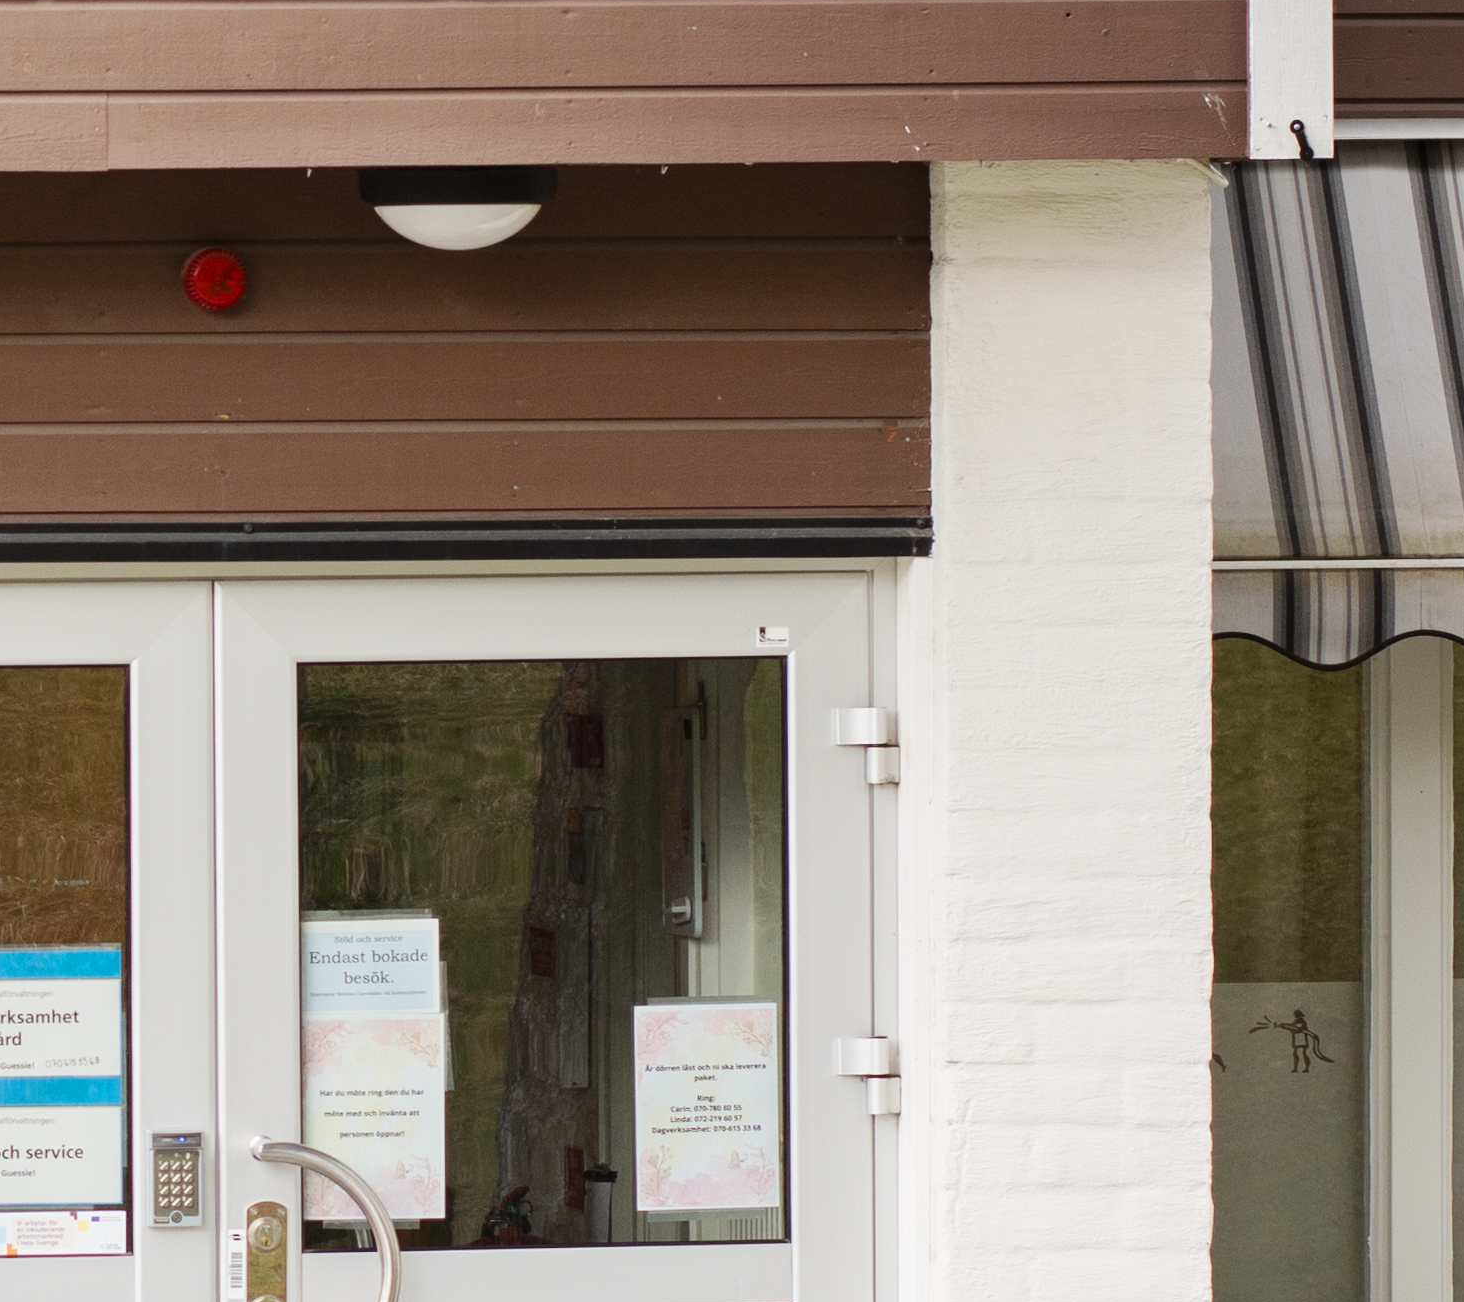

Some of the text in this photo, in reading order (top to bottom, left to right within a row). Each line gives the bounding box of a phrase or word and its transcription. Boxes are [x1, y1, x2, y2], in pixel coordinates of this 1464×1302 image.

[334, 936, 354, 944] Stöd
[356, 936, 372, 944] och
[310, 949, 429, 964] Endast bokade
[344, 971, 394, 984] besök.
[656, 1064, 680, 1072] dörren
[368, 1090, 382, 1098] ring
[753, 1124, 762, 1132] 68
[26, 1144, 84, 1159] service
